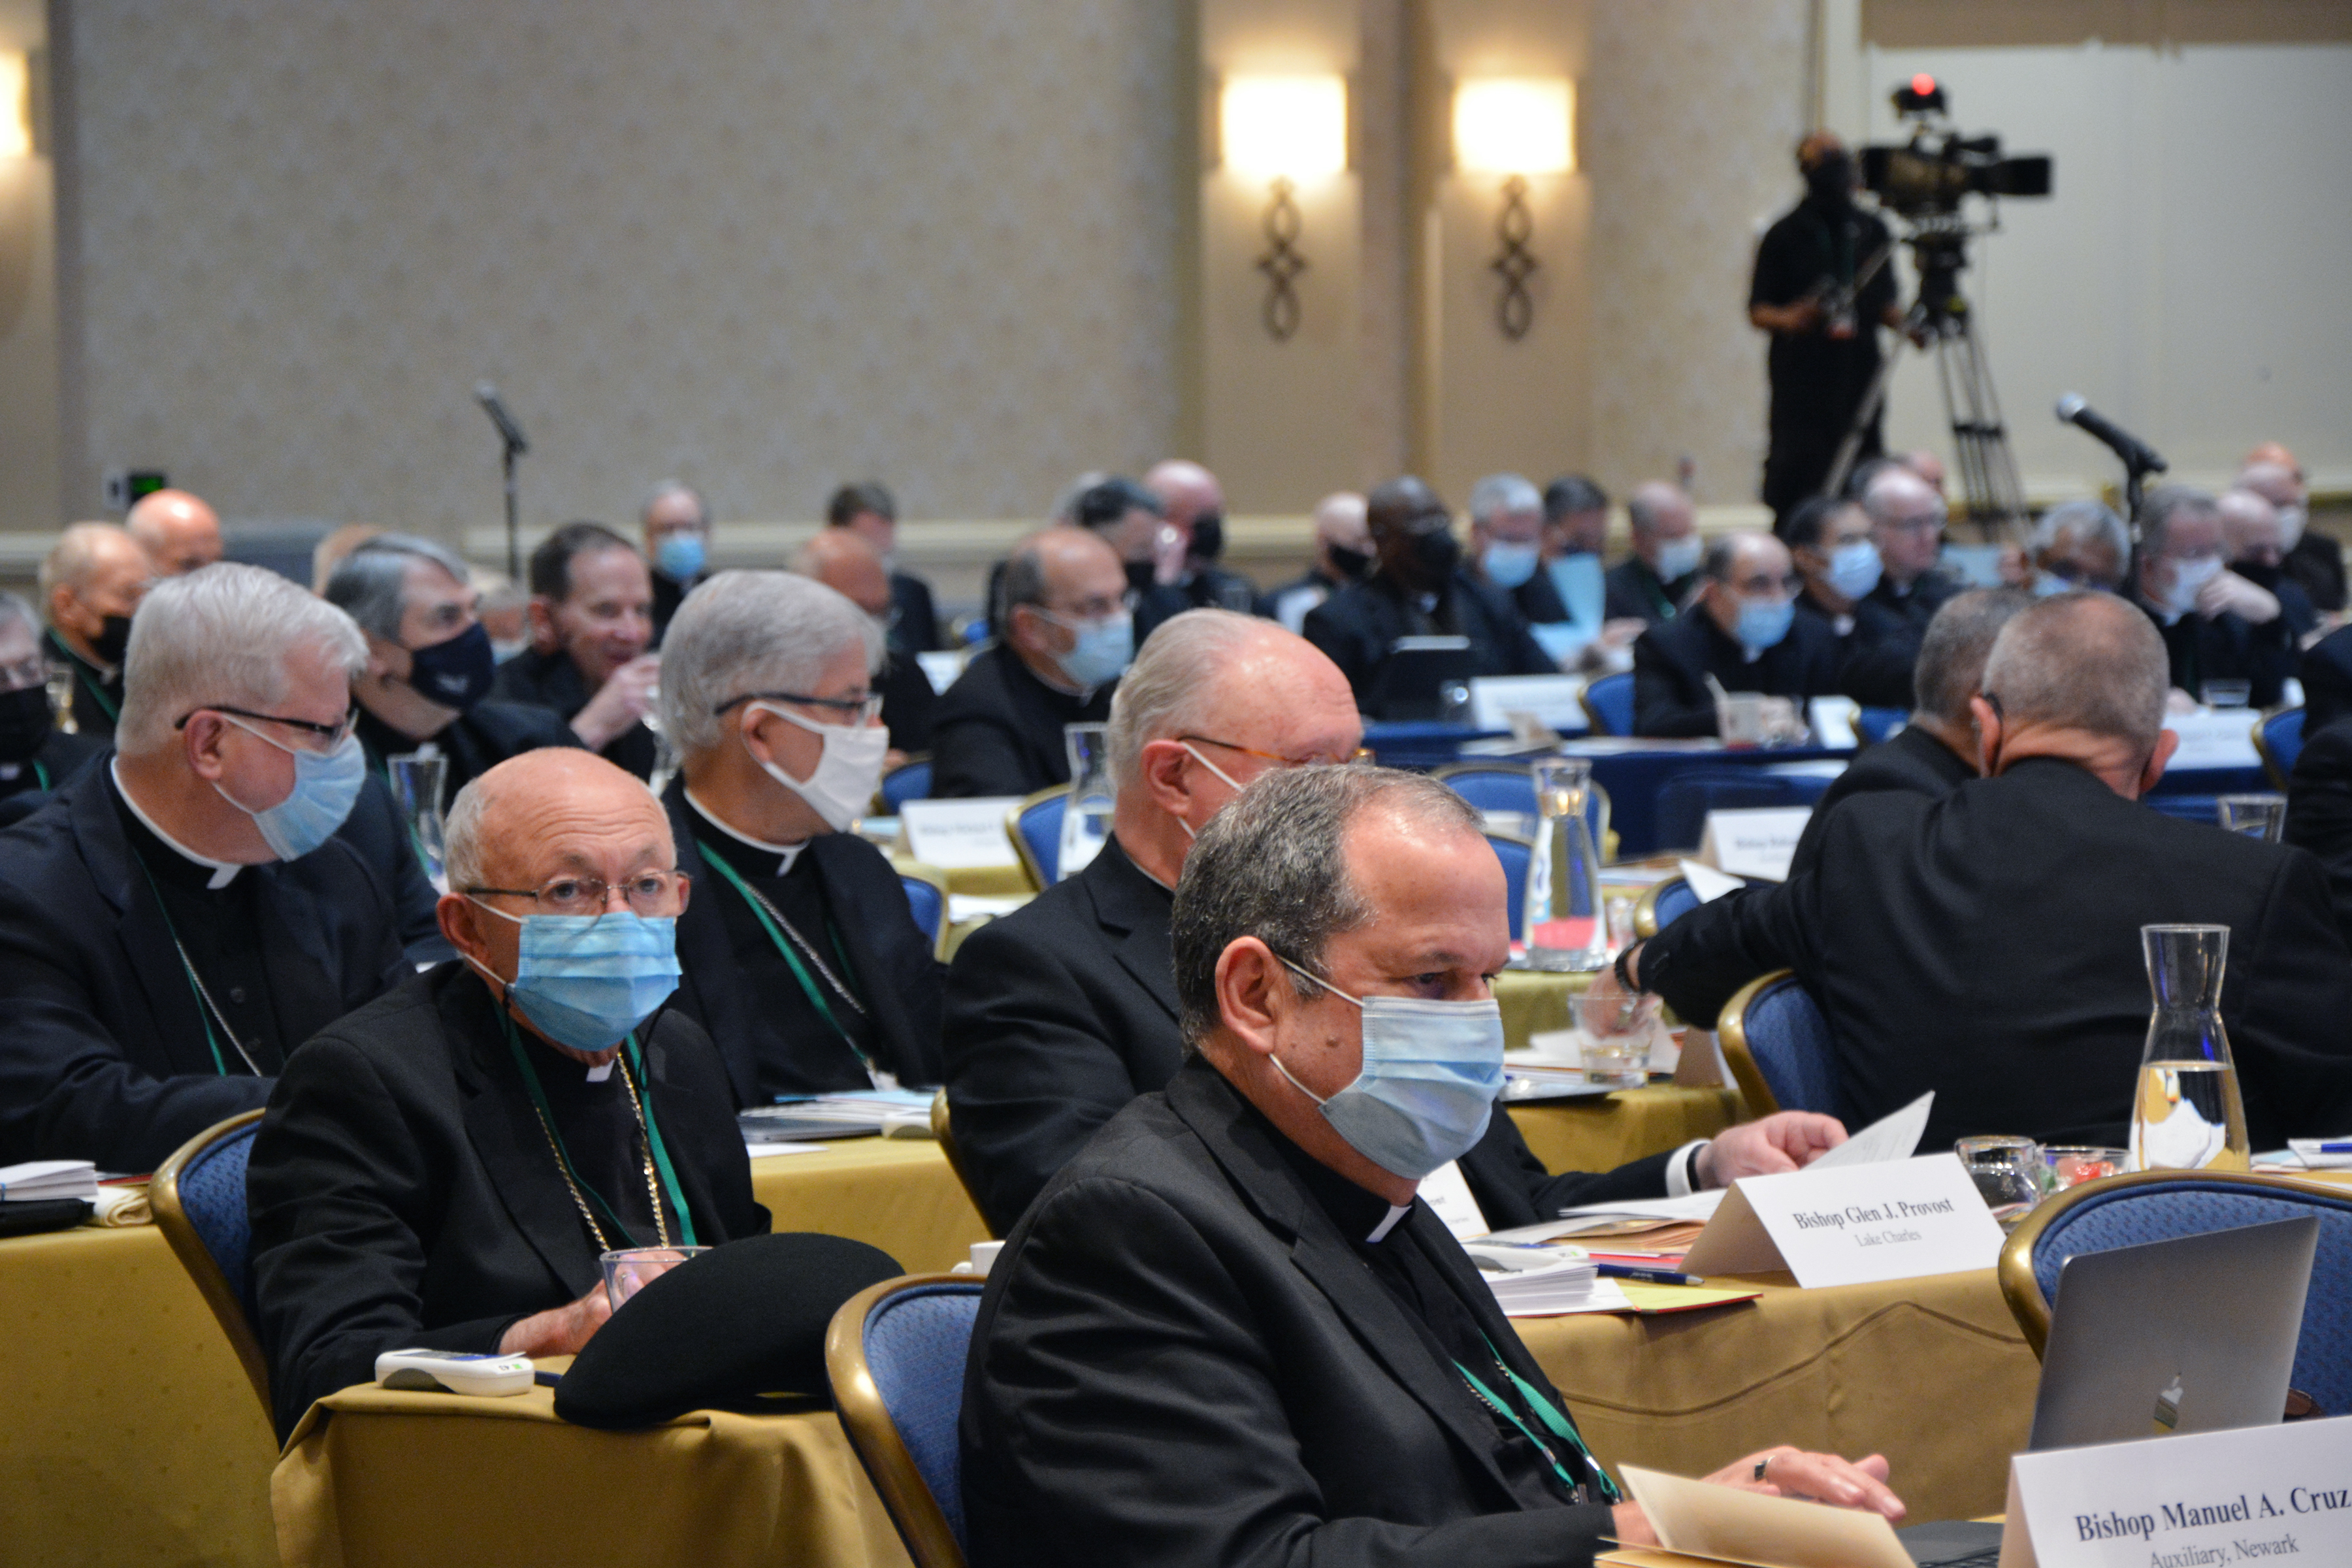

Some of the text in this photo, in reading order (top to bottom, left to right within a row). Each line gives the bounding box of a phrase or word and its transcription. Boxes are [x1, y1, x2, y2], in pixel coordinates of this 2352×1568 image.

[1792, 1198, 1954, 1230] Bishop Glen J. Provost
[1854, 1229, 1922, 1247] Lake Charles
[2074, 1487, 2351, 1542] Bishop Manuel A. Cruz
[2150, 1533, 2300, 1568] Auxiliary, Newark
